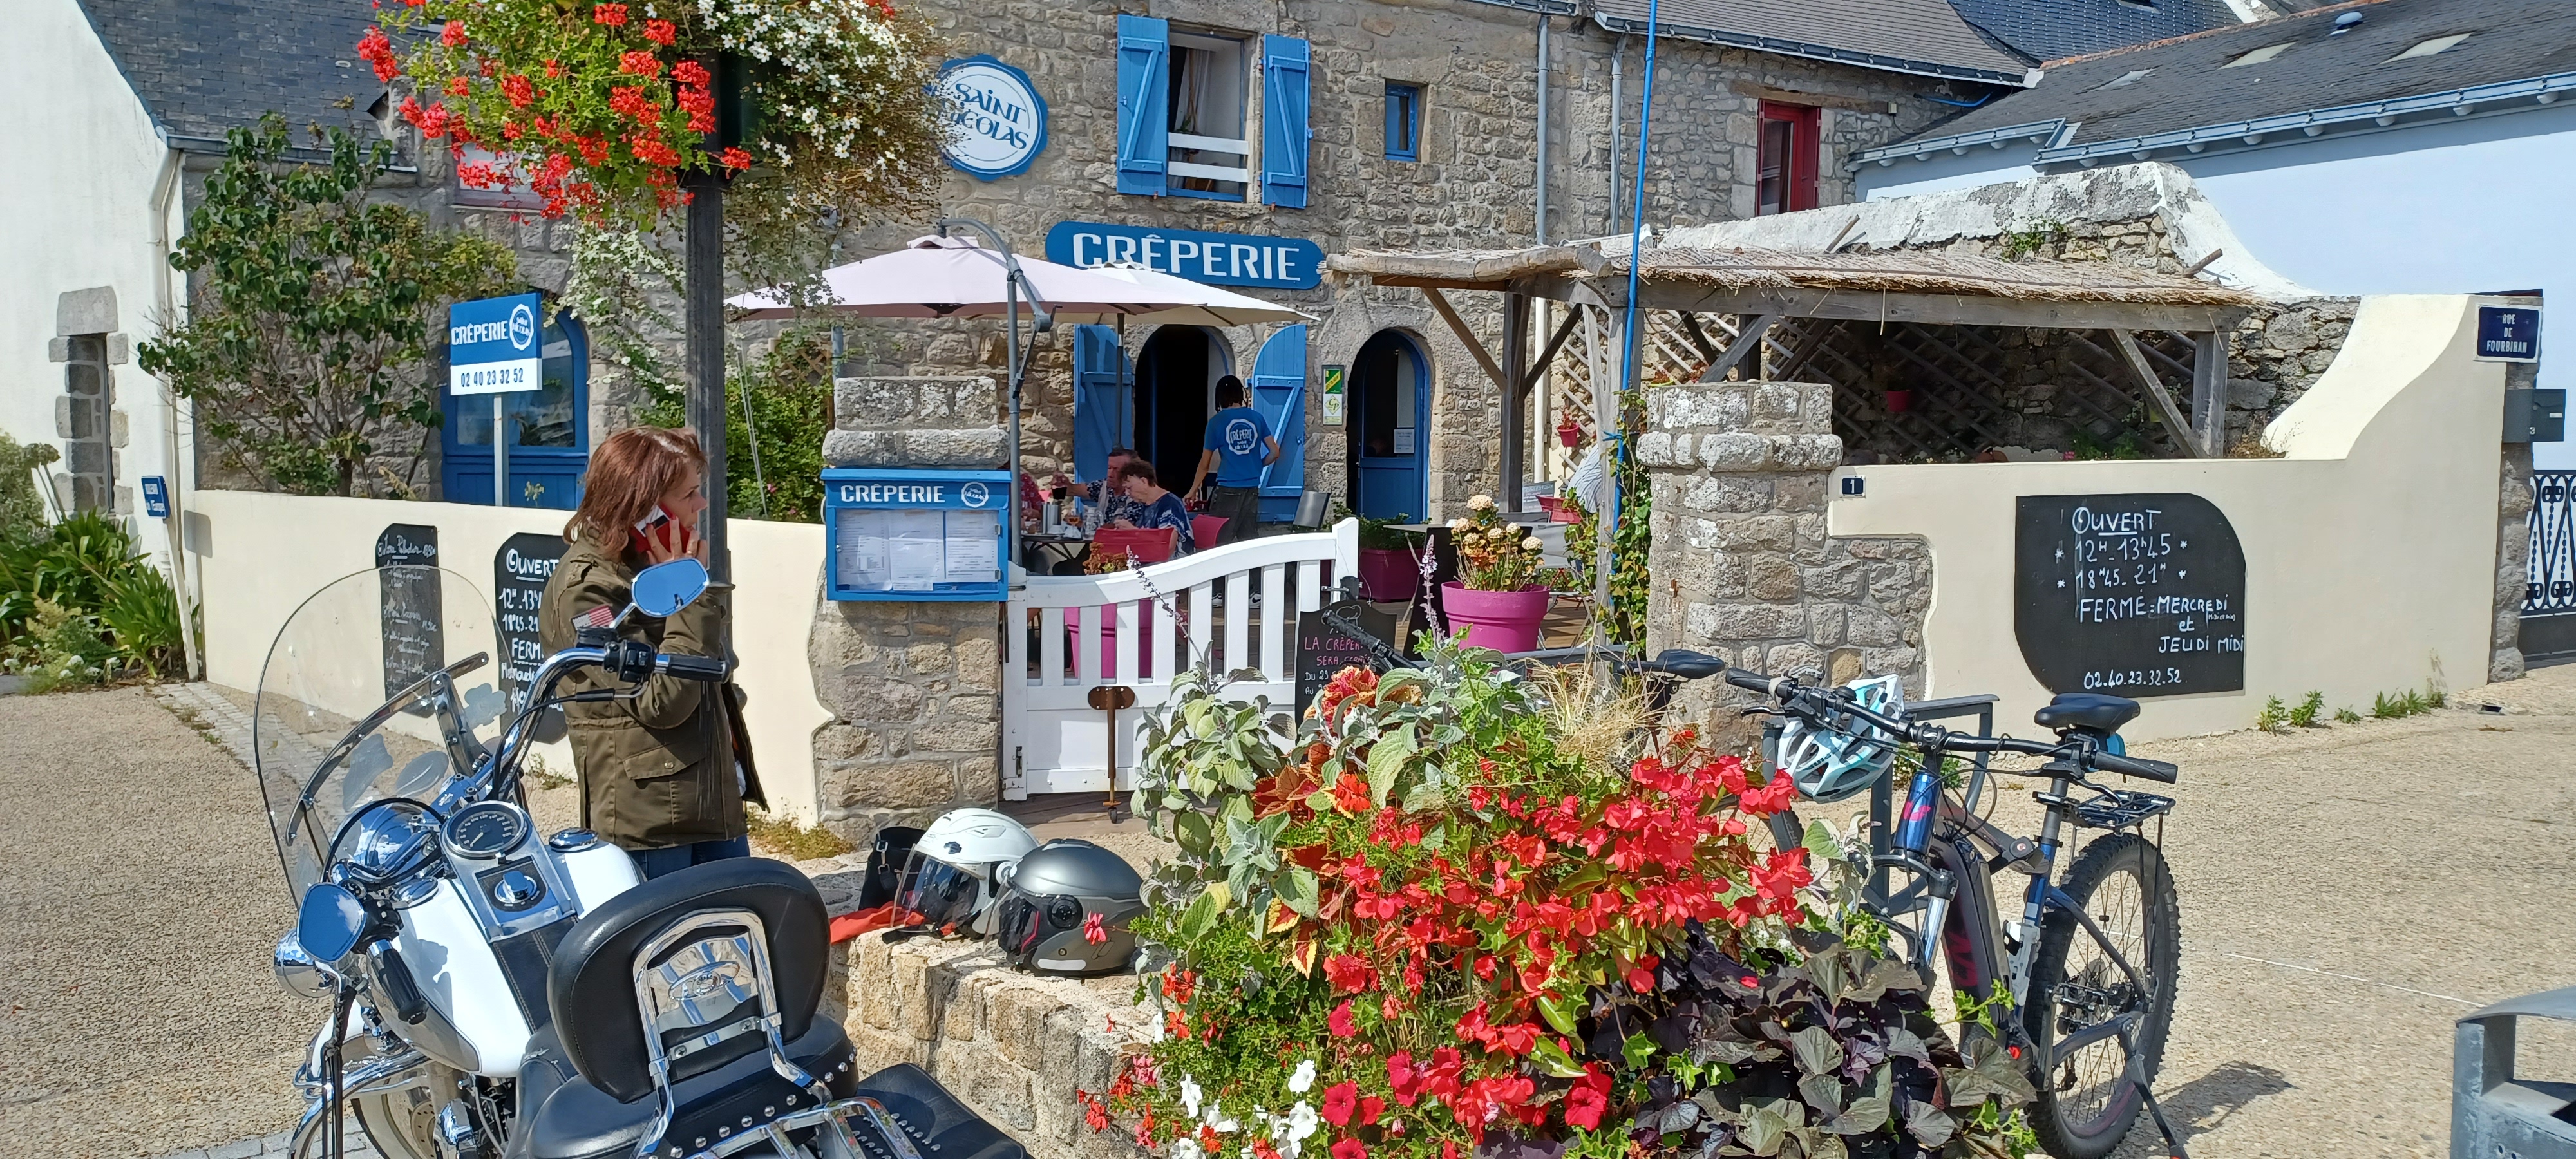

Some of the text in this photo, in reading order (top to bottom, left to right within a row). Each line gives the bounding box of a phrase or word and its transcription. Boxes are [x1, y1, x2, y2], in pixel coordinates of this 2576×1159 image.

[1073, 232, 1301, 281] CRÊPERIE
[2502, 314, 2515, 325] RUE
[451, 321, 508, 345] CRÊPERIE
[2504, 327, 2513, 337] DE
[2486, 340, 2528, 353] FOURBIHAN
[461, 368, 524, 387] 02 40 23 32 52
[2530, 426, 2536, 435] 3
[840, 484, 945, 502] CRÊPERIE
[1850, 479, 1855, 494] 1
[2072, 506, 2161, 534] OUVERT
[506, 548, 559, 577] OUVERT
[511, 637, 544, 660] FERM
[1304, 637, 1320, 650] LA
[1316, 655, 1339, 666] SERA
[1305, 672, 1315, 681] DU
[1305, 686, 1314, 695] AU
